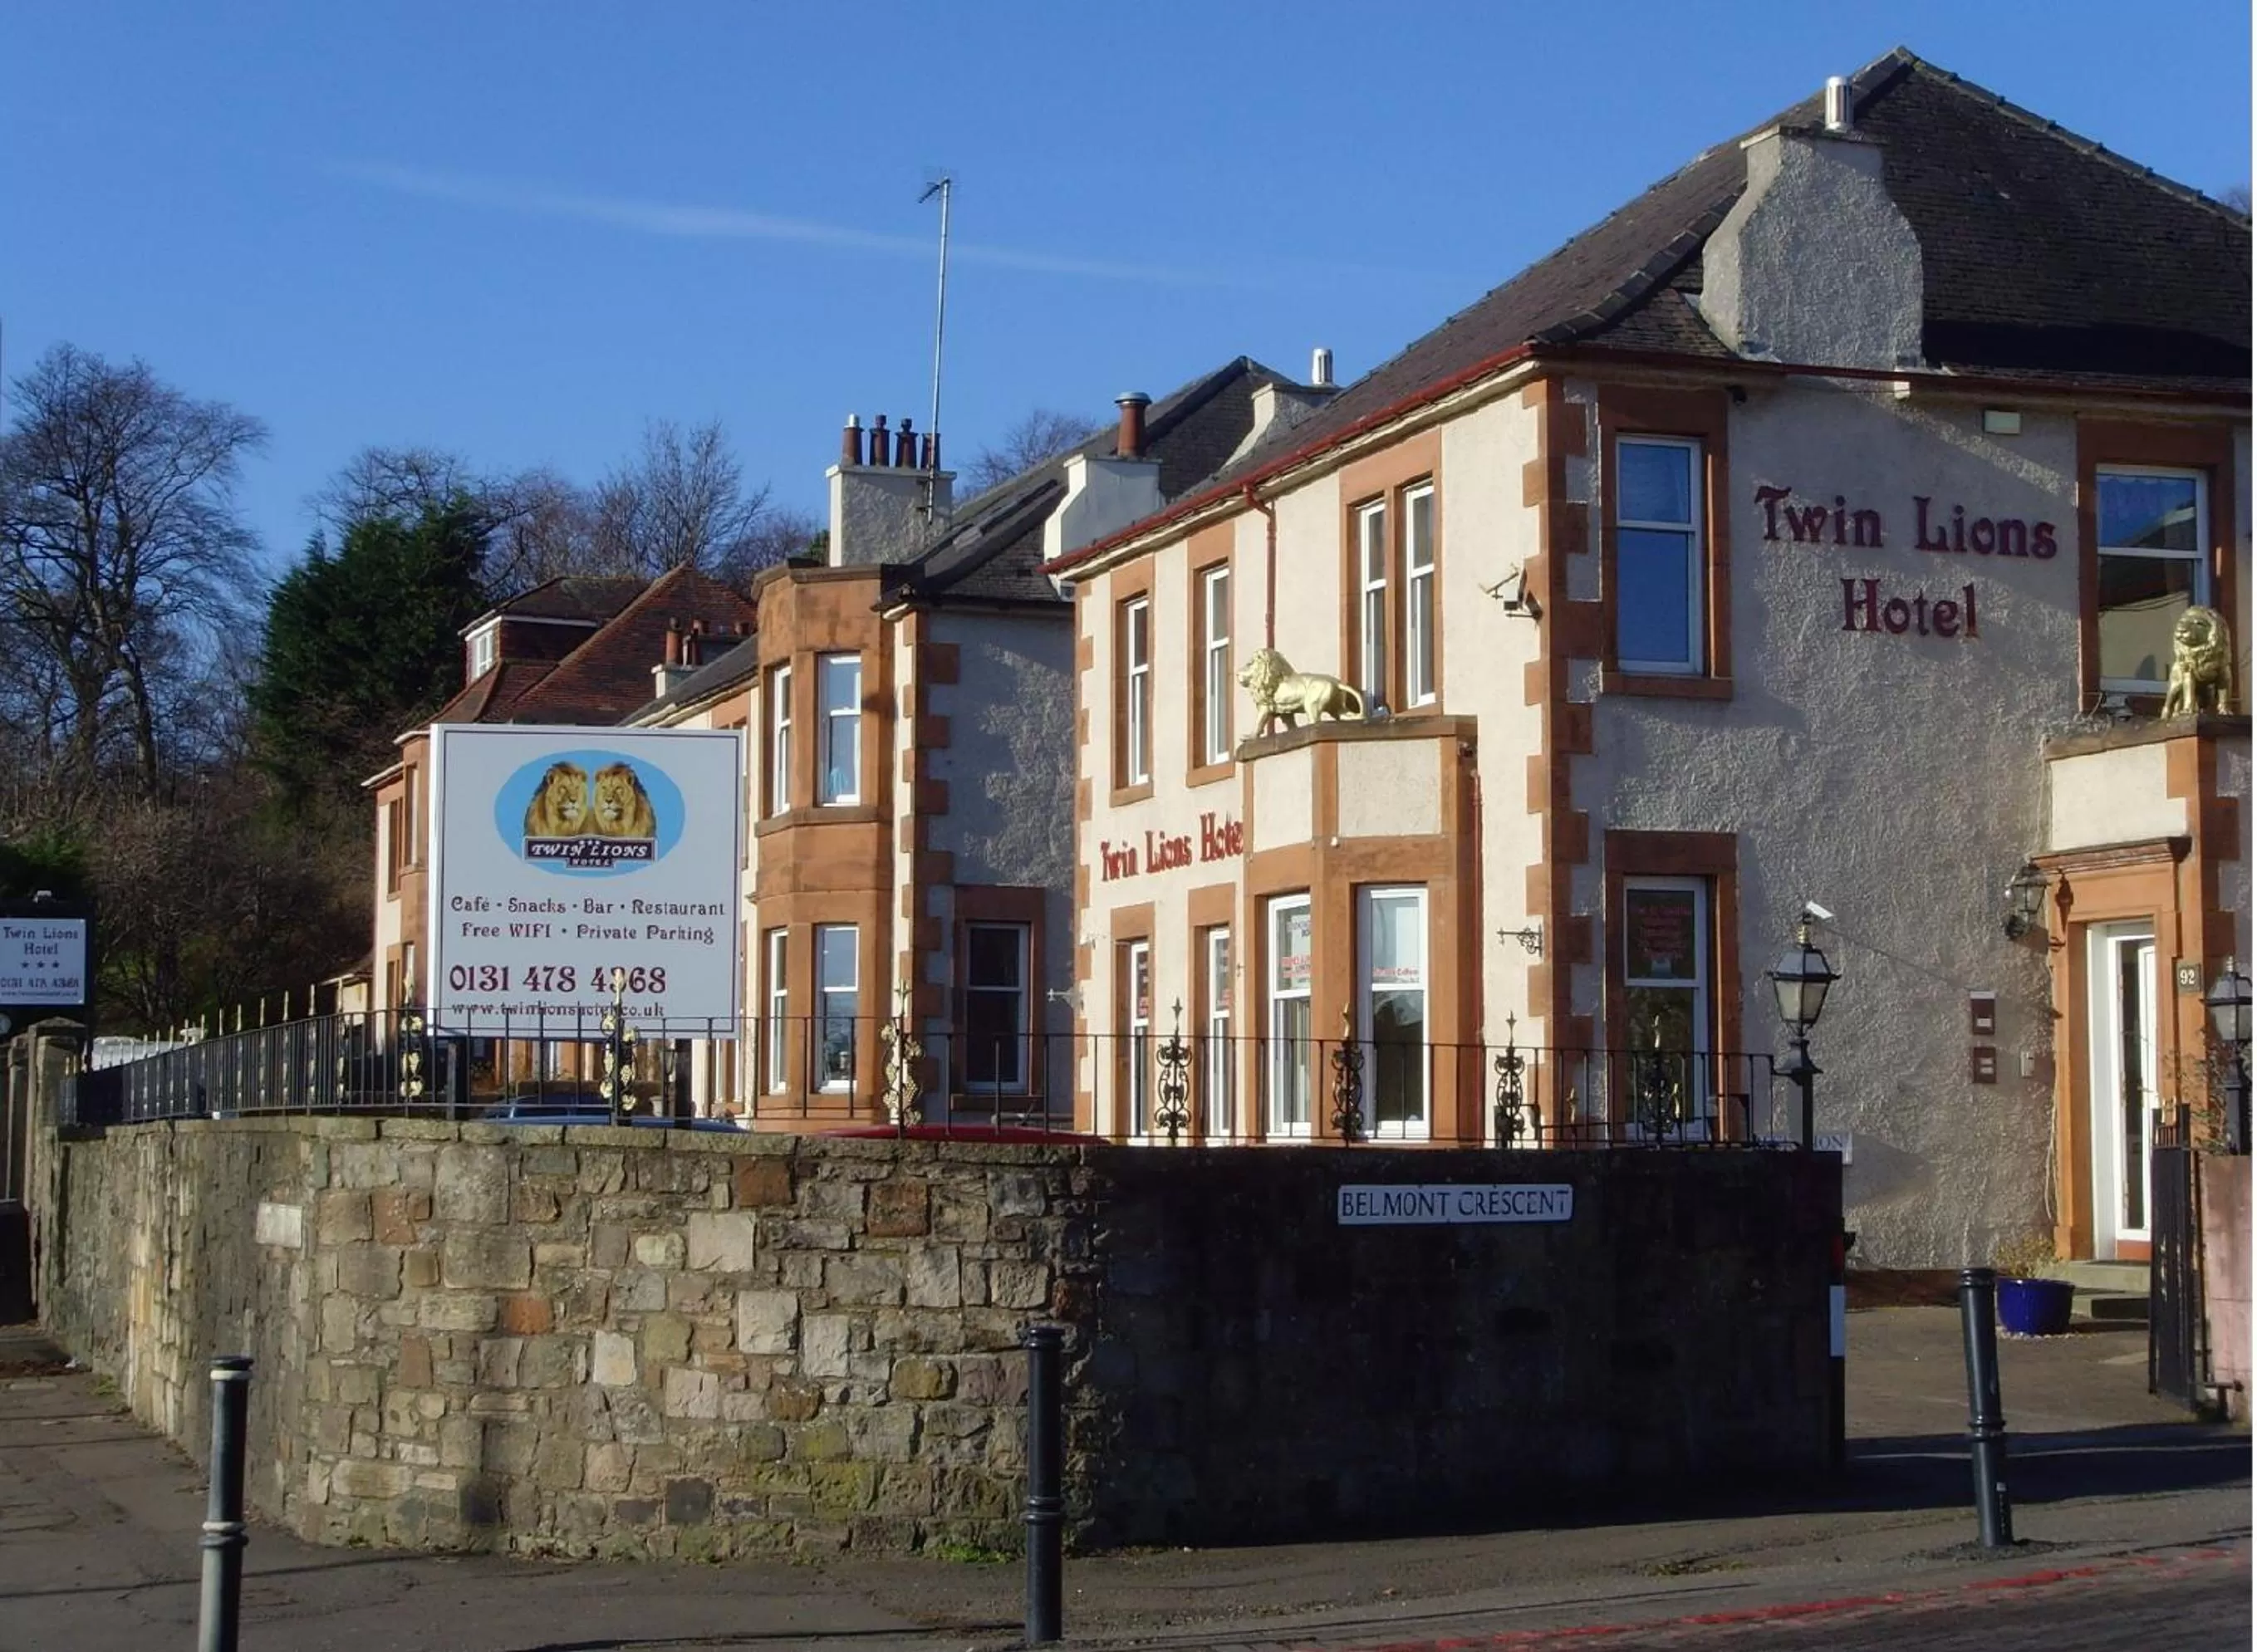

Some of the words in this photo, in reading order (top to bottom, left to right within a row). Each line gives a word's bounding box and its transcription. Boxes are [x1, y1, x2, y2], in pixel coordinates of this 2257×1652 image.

[1754, 485, 1883, 547] Twin
[1913, 496, 2058, 560] Lions
[1840, 578, 1980, 638] Hotel
[531, 843, 585, 856] TWIN
[590, 846, 648, 857] LIONS
[1101, 839, 1140, 881] Twin
[1145, 830, 1193, 873] Lions
[1200, 811, 1244, 862] Hote
[451, 896, 490, 913] Café
[508, 898, 567, 914] Snacks
[583, 899, 614, 914] Bar
[631, 899, 725, 916] Restaurant
[3, 926, 36, 939] Twin
[462, 922, 500, 938] Free
[508, 923, 552, 939] WIFI
[577, 924, 637, 940] Private
[646, 925, 715, 944] Parking
[449, 964, 510, 993] 0131
[523, 965, 577, 993] 478
[2180, 969, 2195, 985] 92
[452, 1000, 665, 1017] www.twinlionshotelco.uk
[1342, 1192, 1450, 1216] BELMONT
[1459, 1189, 1570, 1215] CRESCENT
